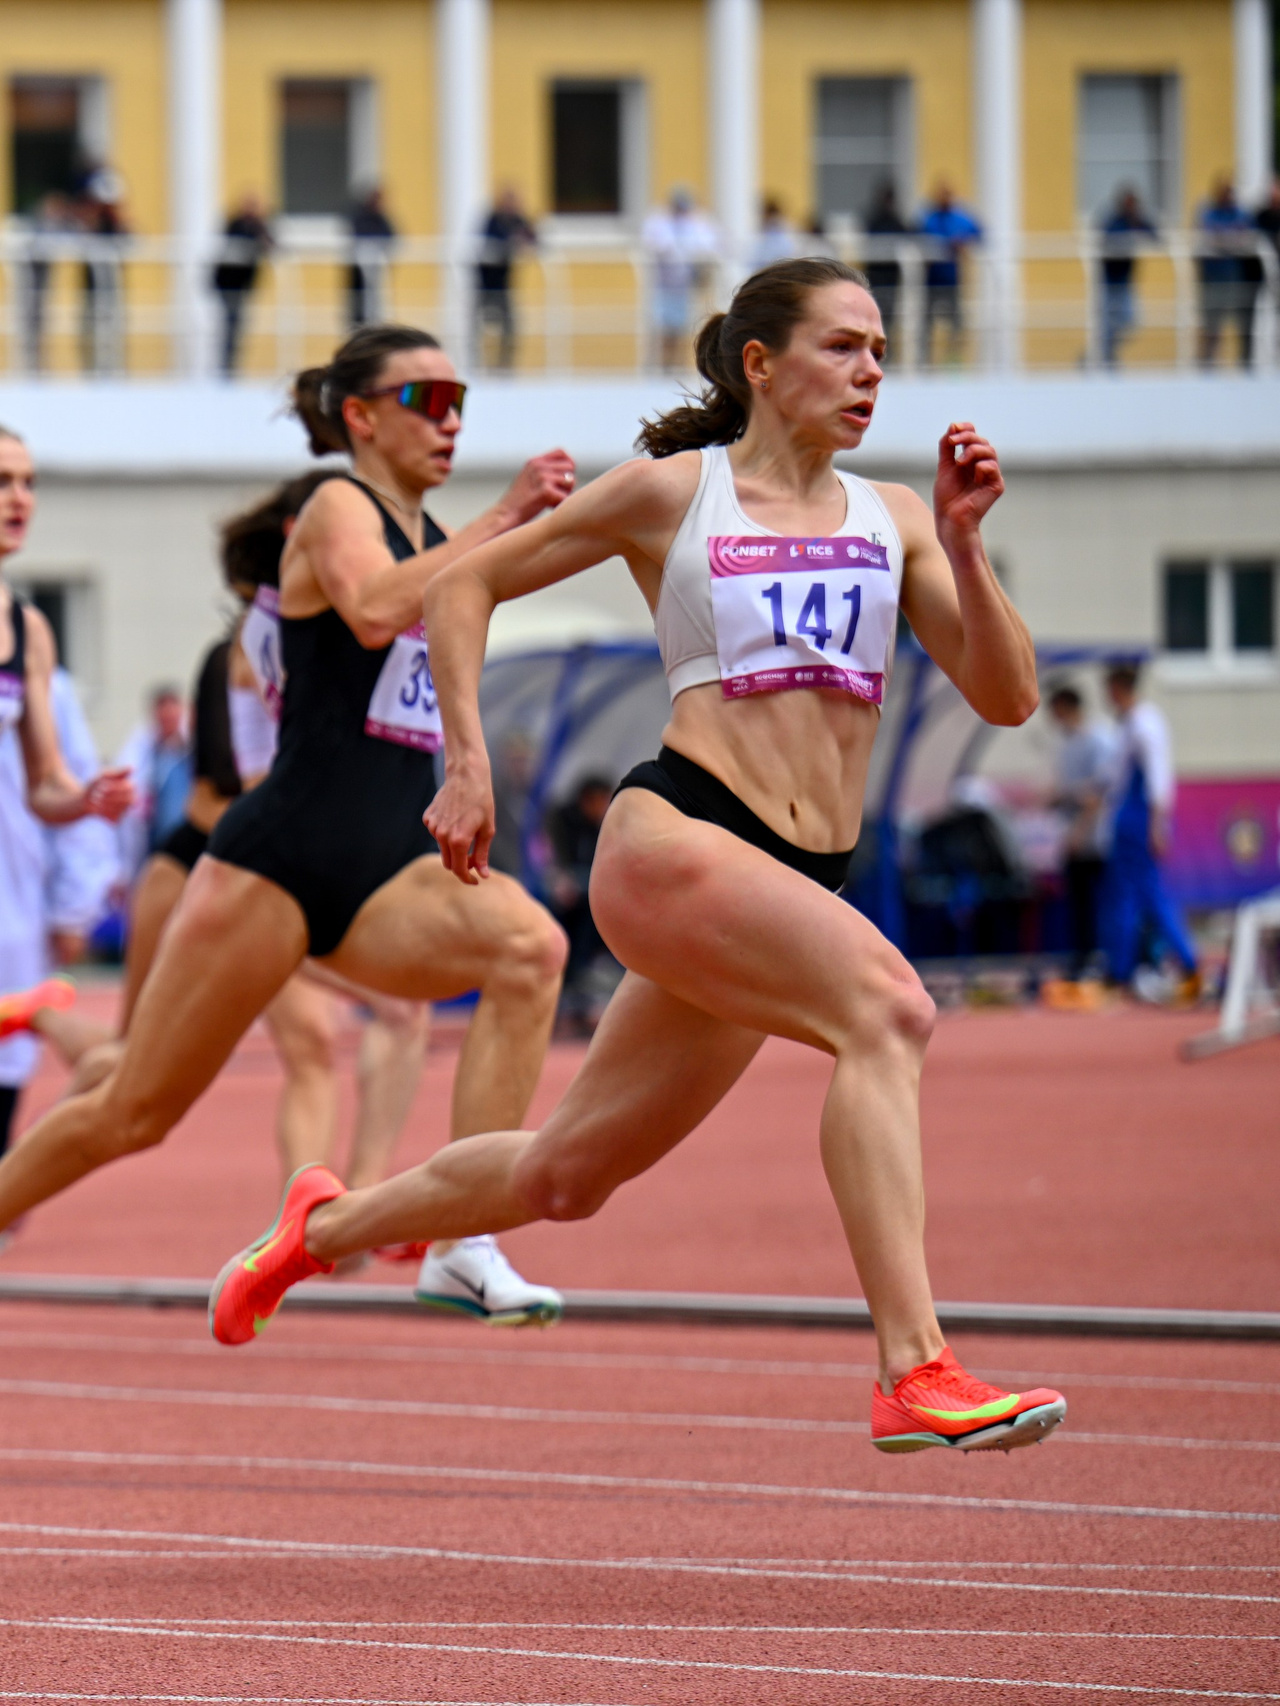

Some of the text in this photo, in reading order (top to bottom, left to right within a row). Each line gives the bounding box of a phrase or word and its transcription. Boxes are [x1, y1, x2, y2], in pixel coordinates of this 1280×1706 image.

[721, 545, 777, 557] FONBET
[806, 545, 834, 556] ПСБ
[761, 582, 861, 655] 141
